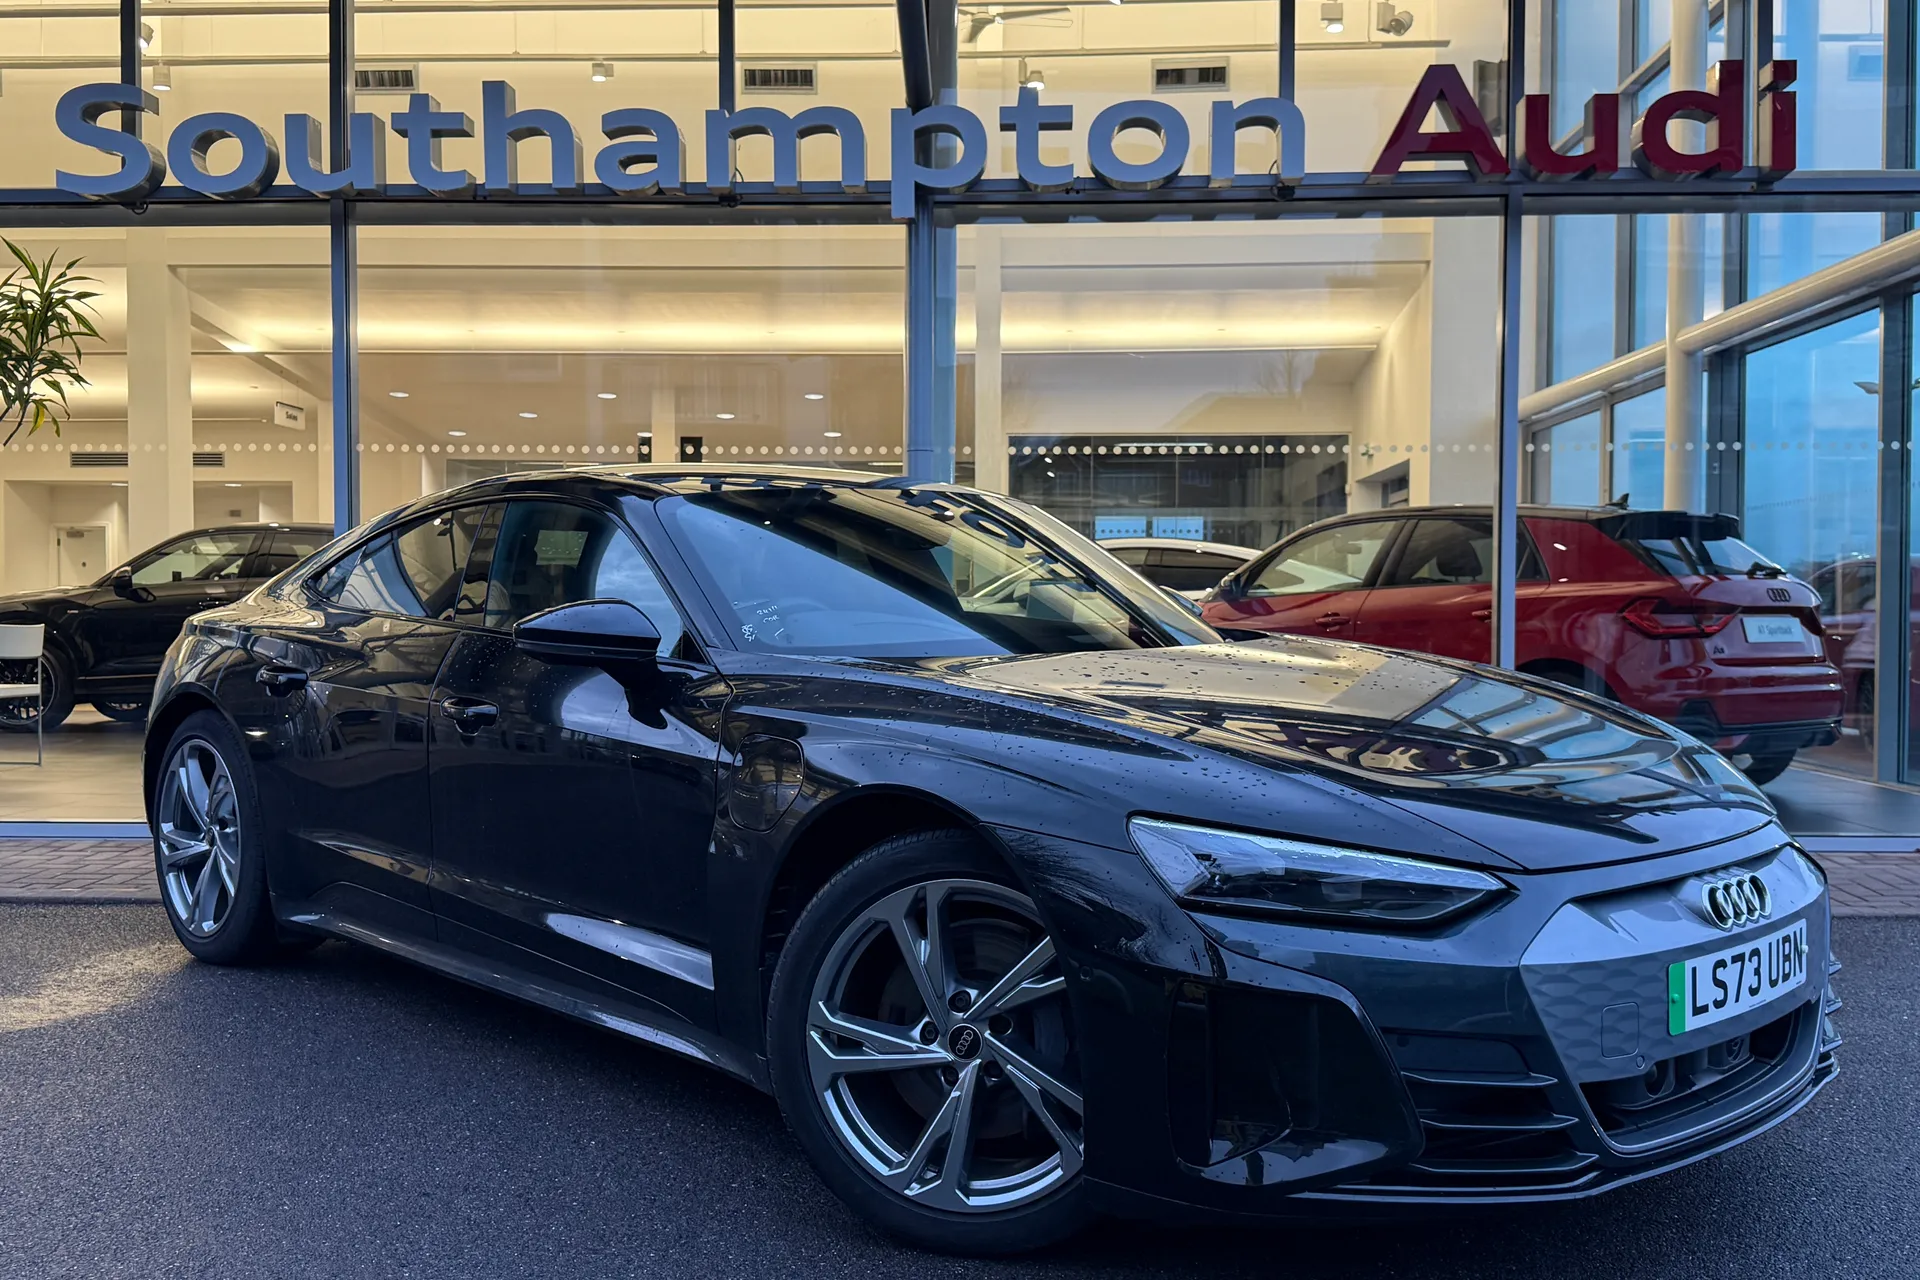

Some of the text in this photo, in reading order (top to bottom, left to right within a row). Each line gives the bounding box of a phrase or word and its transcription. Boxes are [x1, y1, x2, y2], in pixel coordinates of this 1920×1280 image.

[55, 59, 1798, 219] Southampton Audi
[1691, 926, 1803, 1017] LS73 UBN
